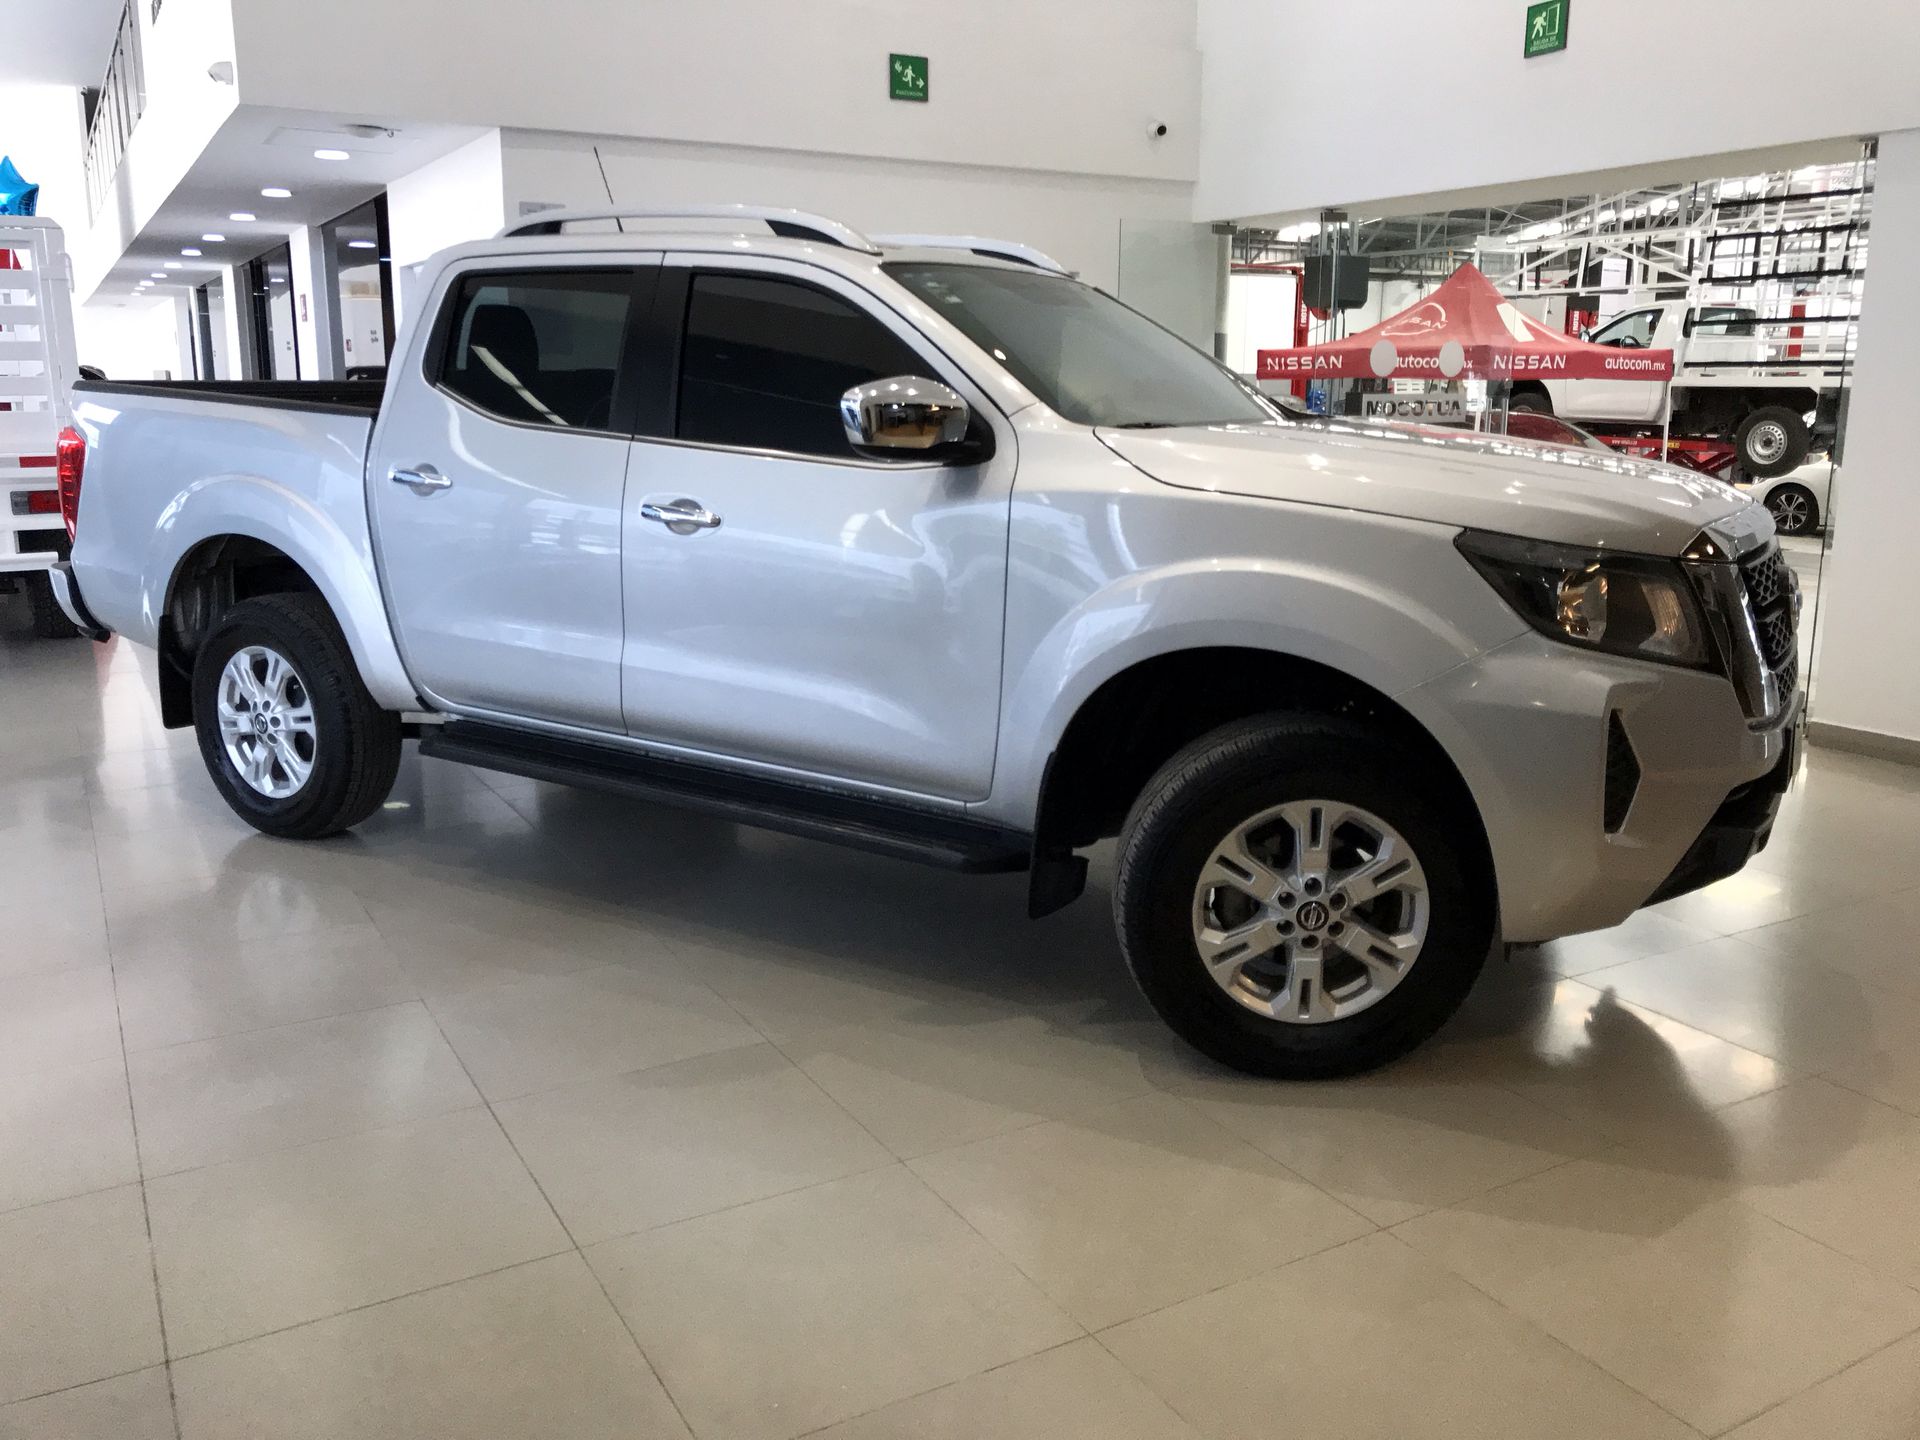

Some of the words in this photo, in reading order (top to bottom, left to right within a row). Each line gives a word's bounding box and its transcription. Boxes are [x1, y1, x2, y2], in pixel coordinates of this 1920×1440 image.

[1267, 355, 1343, 371] NISSAN
[1493, 355, 1567, 370] NISSAN
[1605, 357, 1666, 371] autocom.mx
